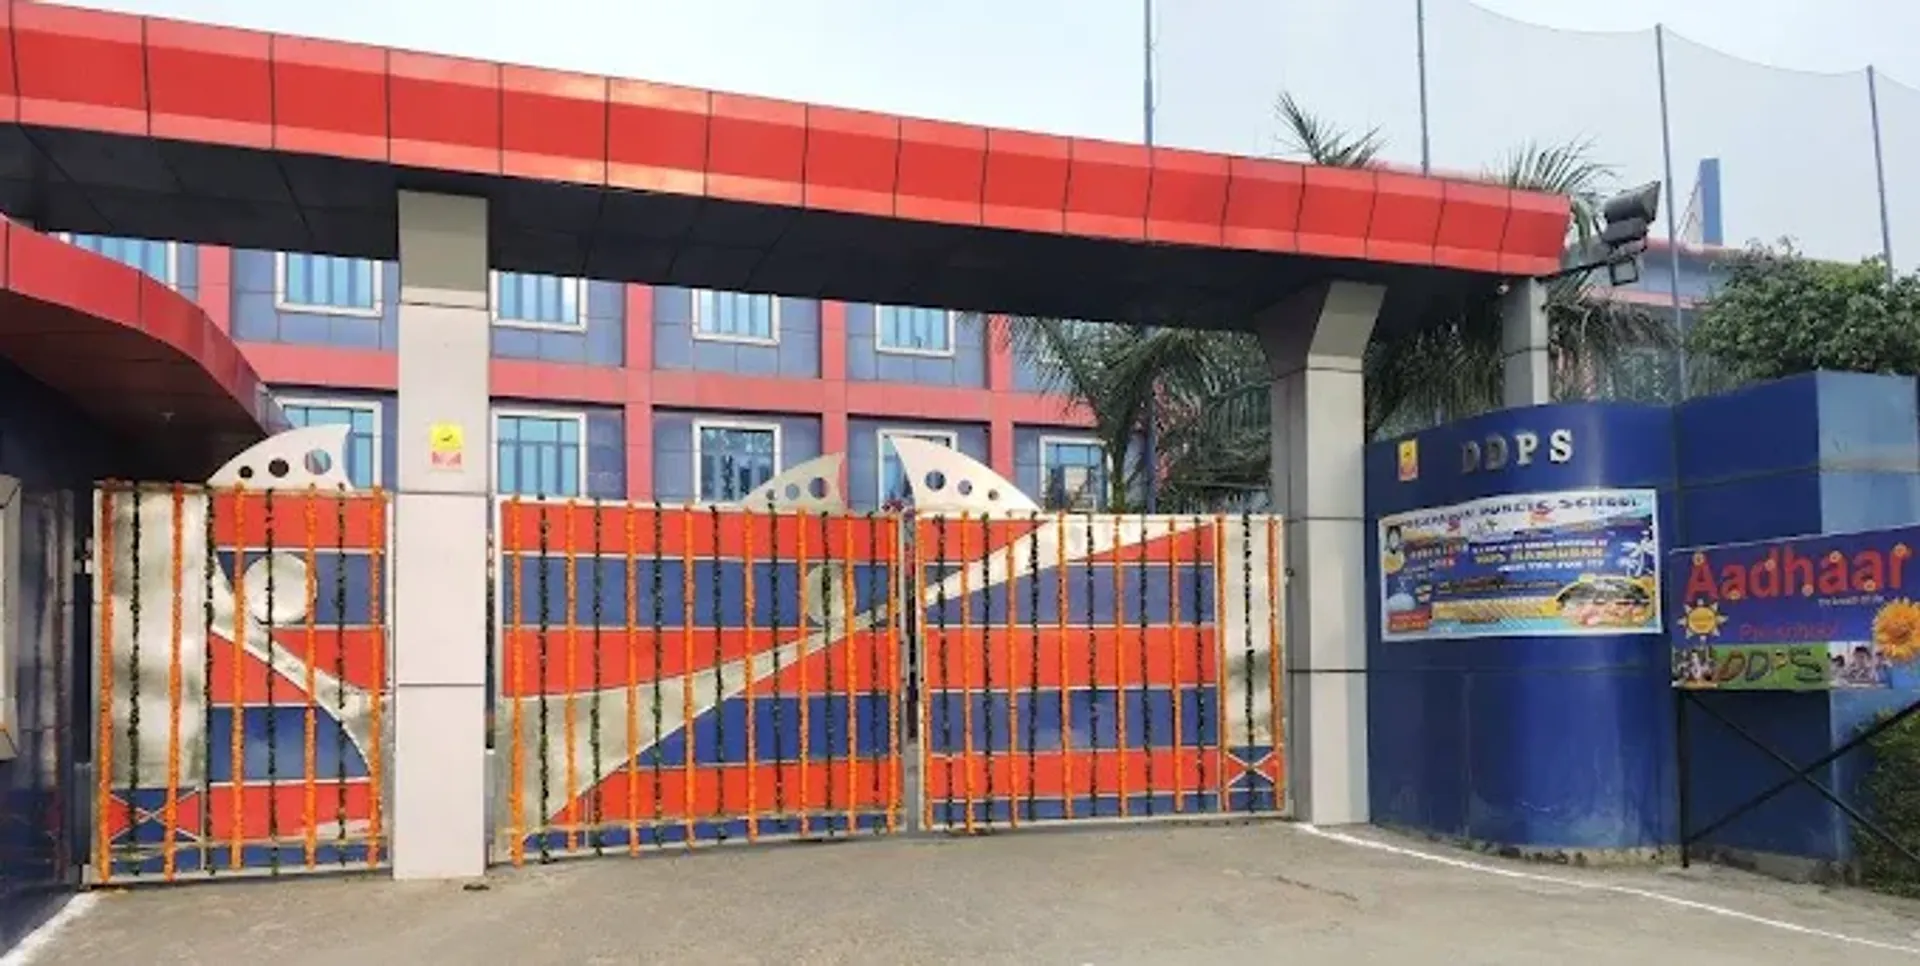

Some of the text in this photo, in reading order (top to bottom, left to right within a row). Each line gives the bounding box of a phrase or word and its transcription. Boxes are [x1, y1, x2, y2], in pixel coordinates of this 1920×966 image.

[1462, 429, 1574, 474] DDPS
[1558, 496, 1641, 510] SCHOOL
[1684, 544, 1913, 603] Aadhaar
